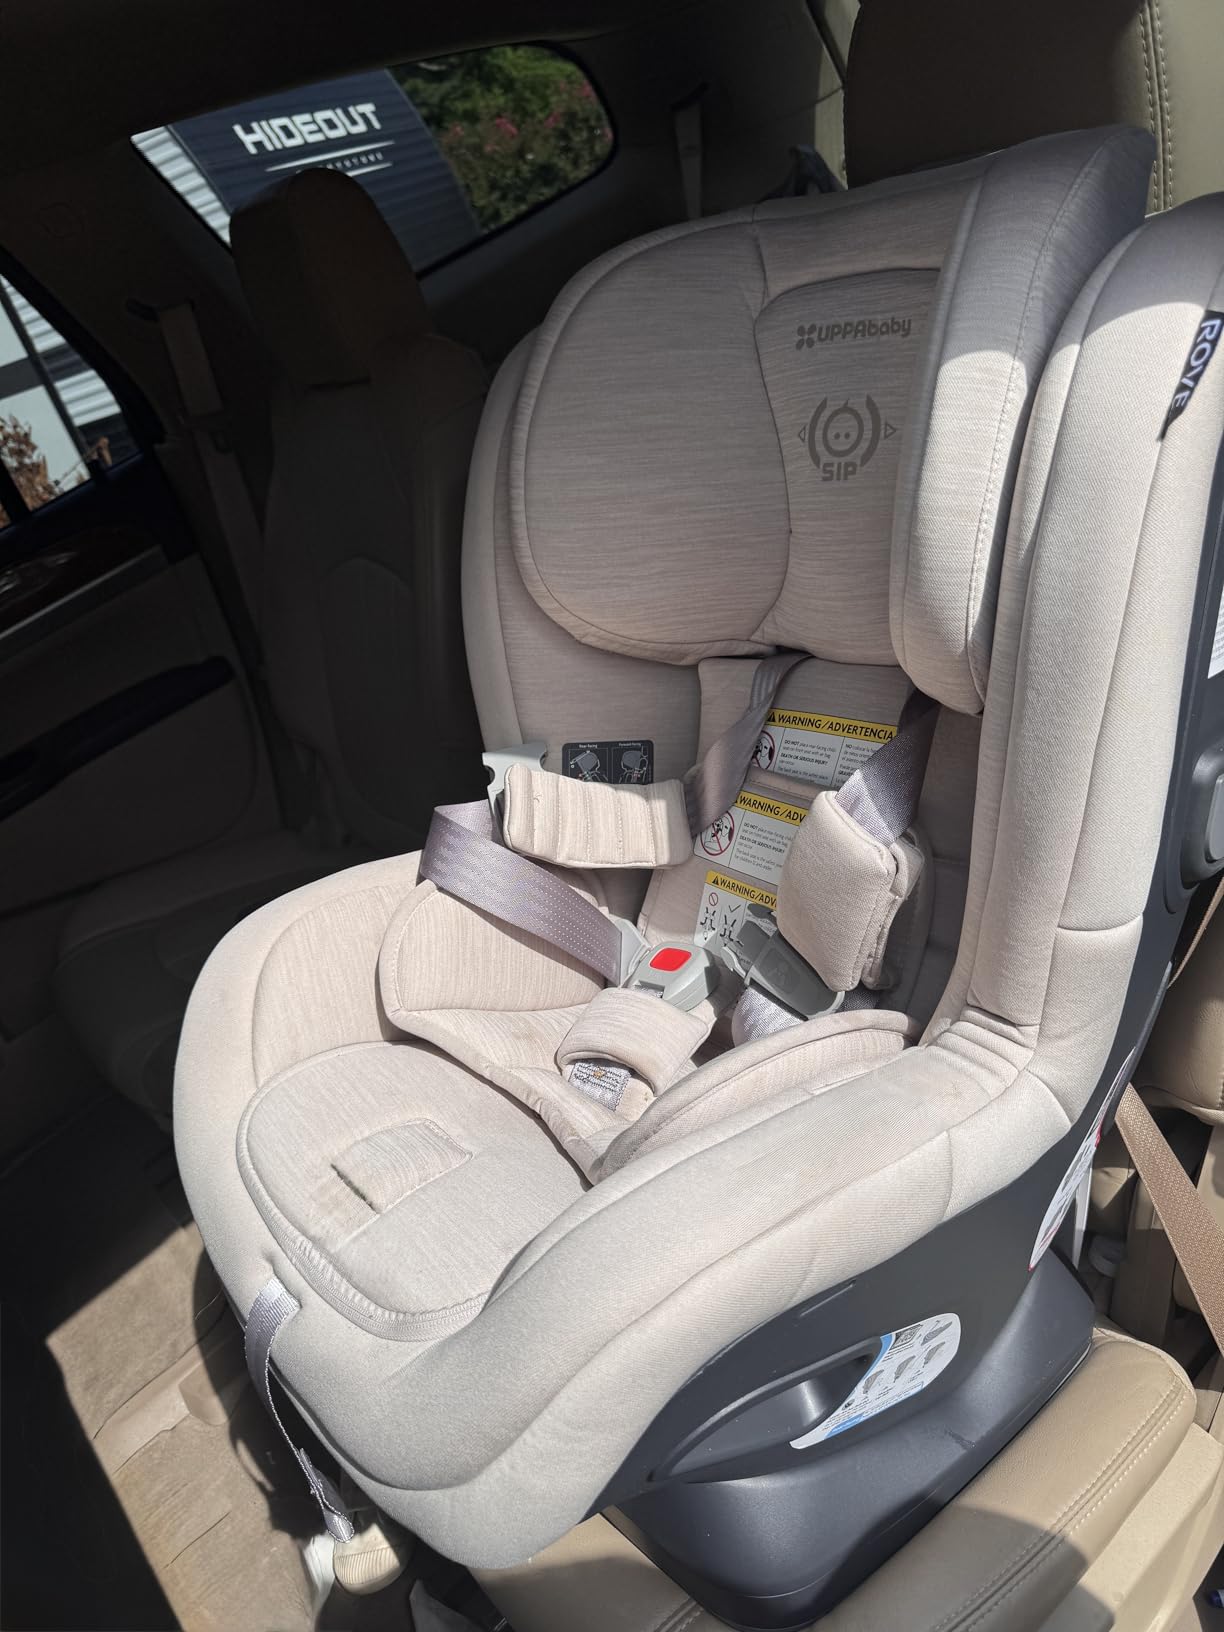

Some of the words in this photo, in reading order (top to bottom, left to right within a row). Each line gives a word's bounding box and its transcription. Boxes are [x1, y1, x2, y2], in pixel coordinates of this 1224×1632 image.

[232, 102, 381, 154] HIDEOUT
[817, 317, 911, 342] UPPAbaby
[1172, 319, 1221, 408] ROVE
[821, 461, 858, 482] SIP
[778, 713, 893, 741] WARNING/ADVERTENCIA
[720, 877, 776, 908] WARNING/ADV
